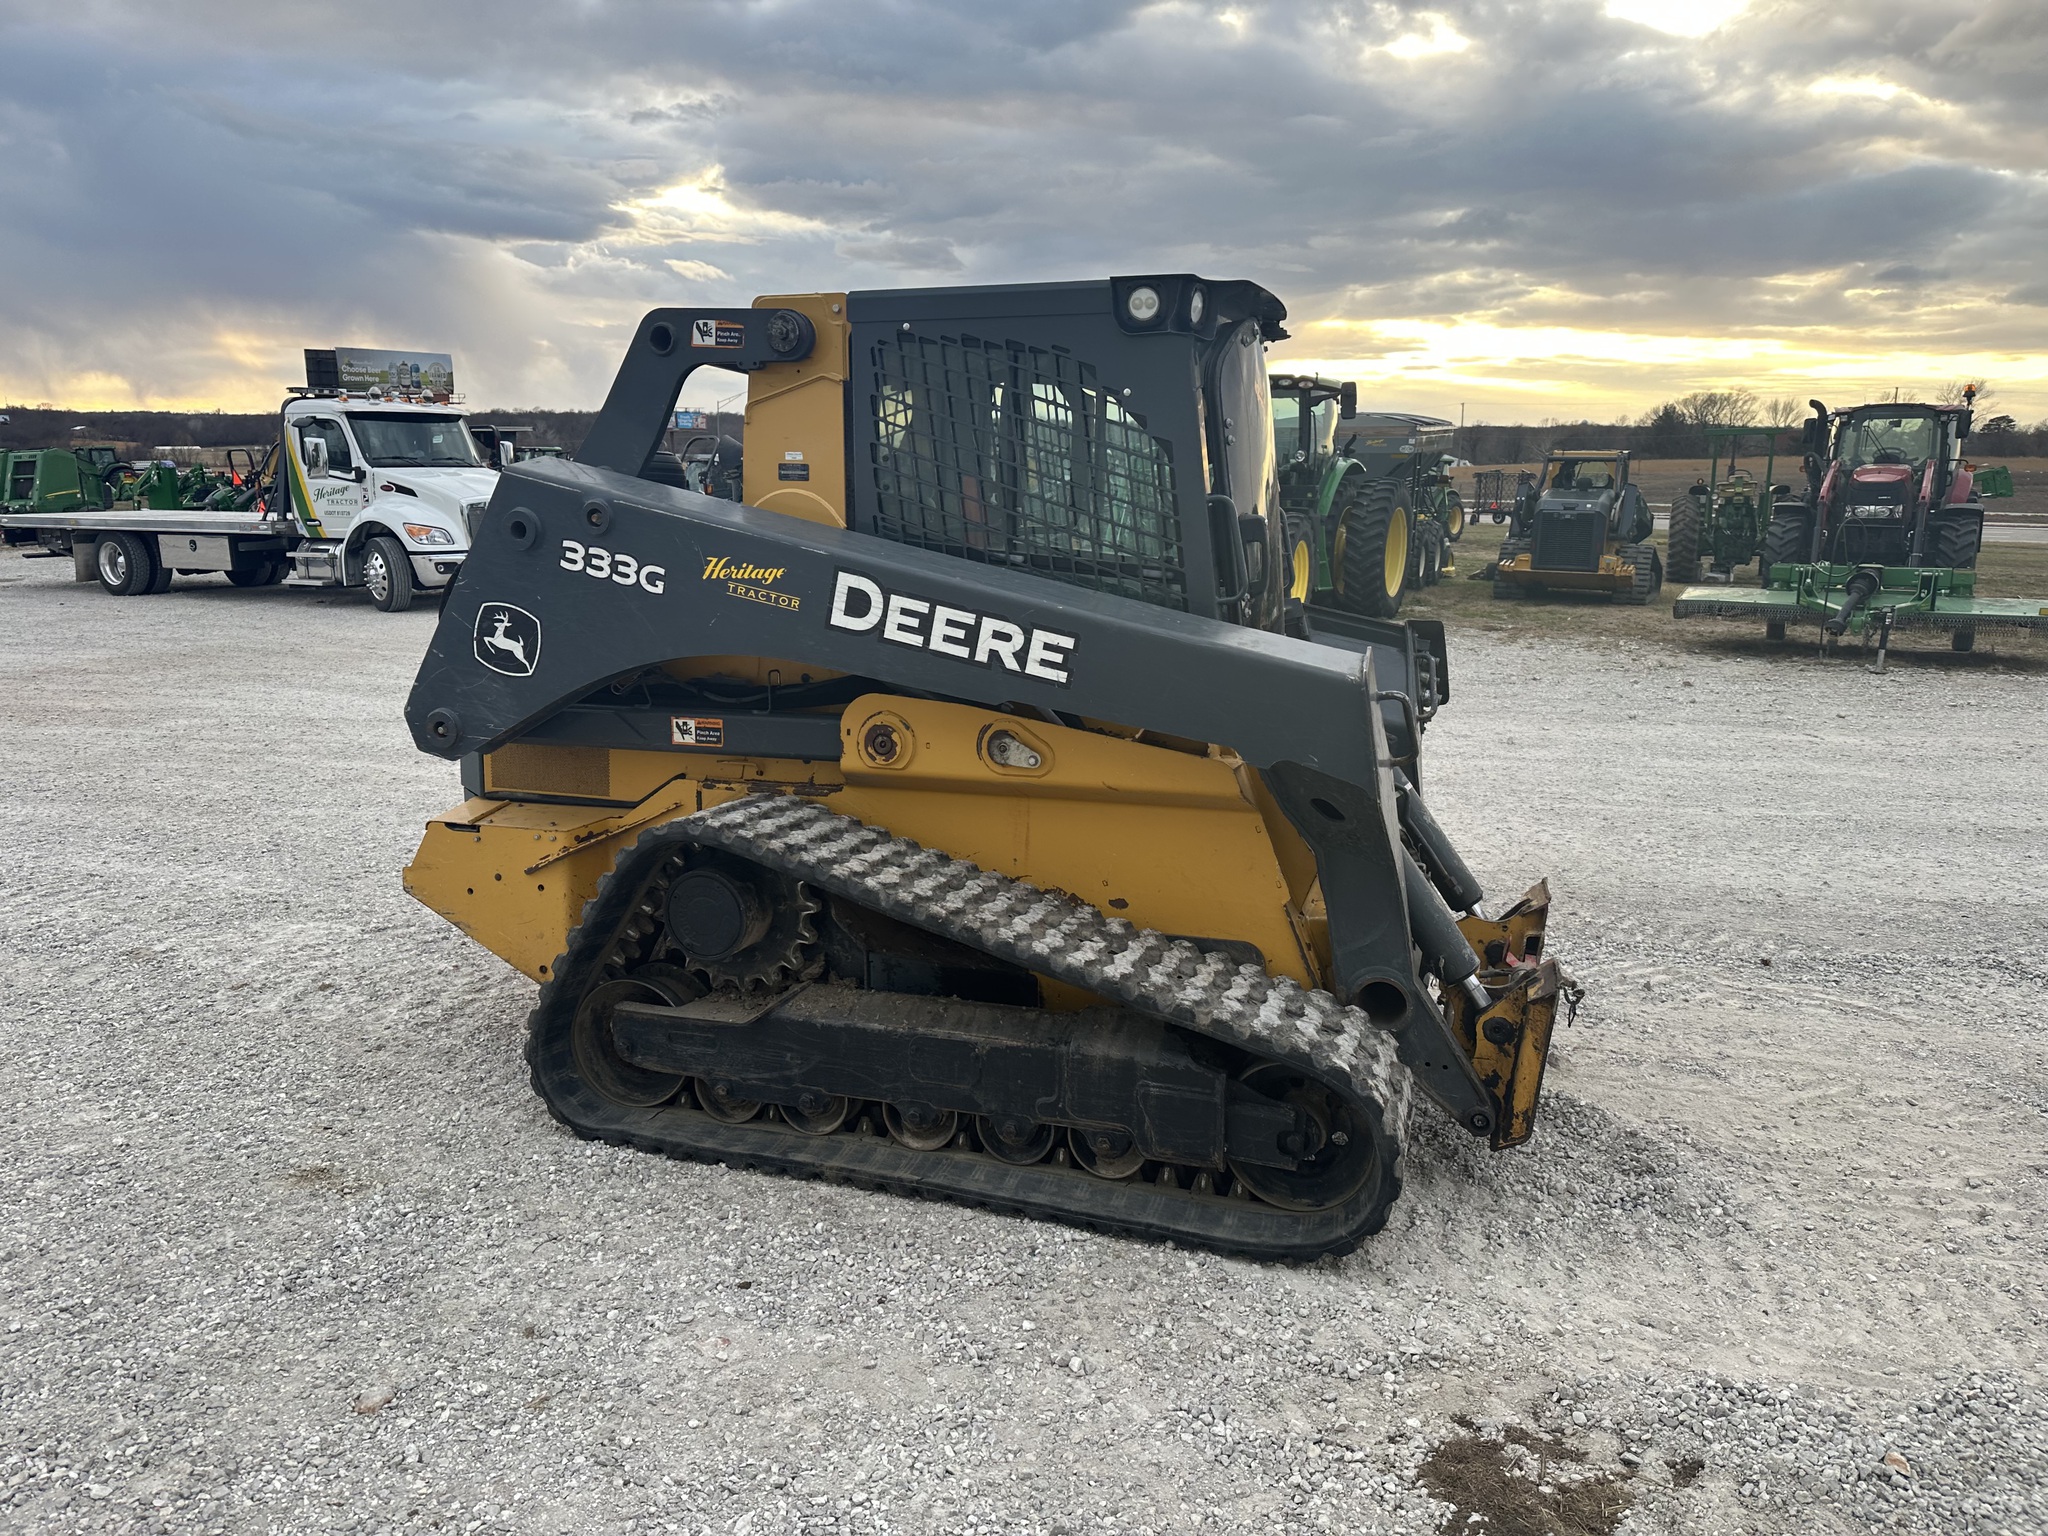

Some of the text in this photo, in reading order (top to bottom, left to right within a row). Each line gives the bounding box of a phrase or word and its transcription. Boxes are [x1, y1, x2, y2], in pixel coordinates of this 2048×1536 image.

[341, 364, 382, 374] Choose Beer
[342, 373, 364, 381] Grown
[364, 375, 380, 383] Here
[313, 485, 350, 503] Heritage
[560, 540, 666, 594] 333G
[702, 556, 787, 585] Heritage
[727, 583, 800, 609] TRACTOR
[830, 571, 1076, 683] DEERE
